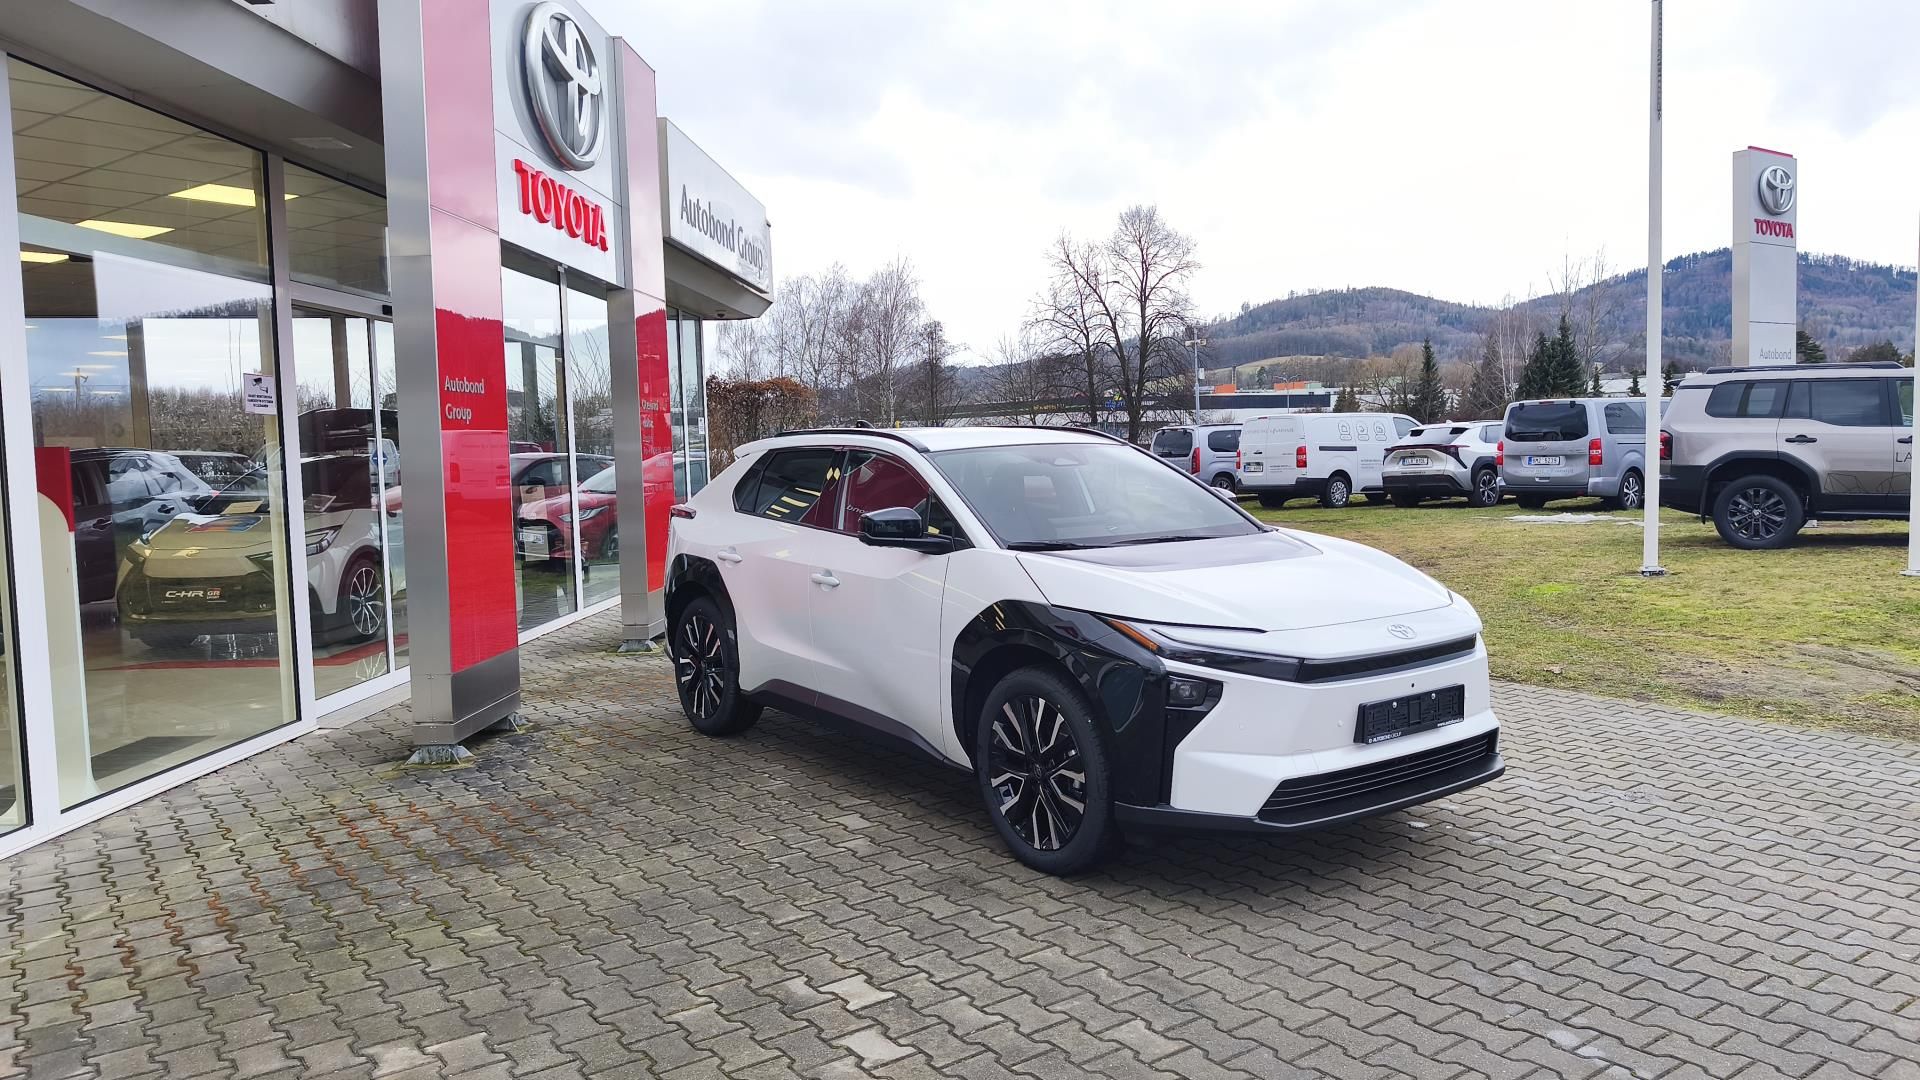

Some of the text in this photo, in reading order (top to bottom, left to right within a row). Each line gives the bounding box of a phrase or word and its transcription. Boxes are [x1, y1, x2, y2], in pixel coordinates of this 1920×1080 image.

[511, 158, 609, 252] TOYOTA
[680, 184, 763, 280] Autobond Group
[1753, 218, 1794, 239] TOYOTA
[1759, 347, 1792, 360] Autobond
[444, 376, 485, 394] Autobond
[445, 403, 472, 424] Group
[165, 590, 204, 598] C-HR
